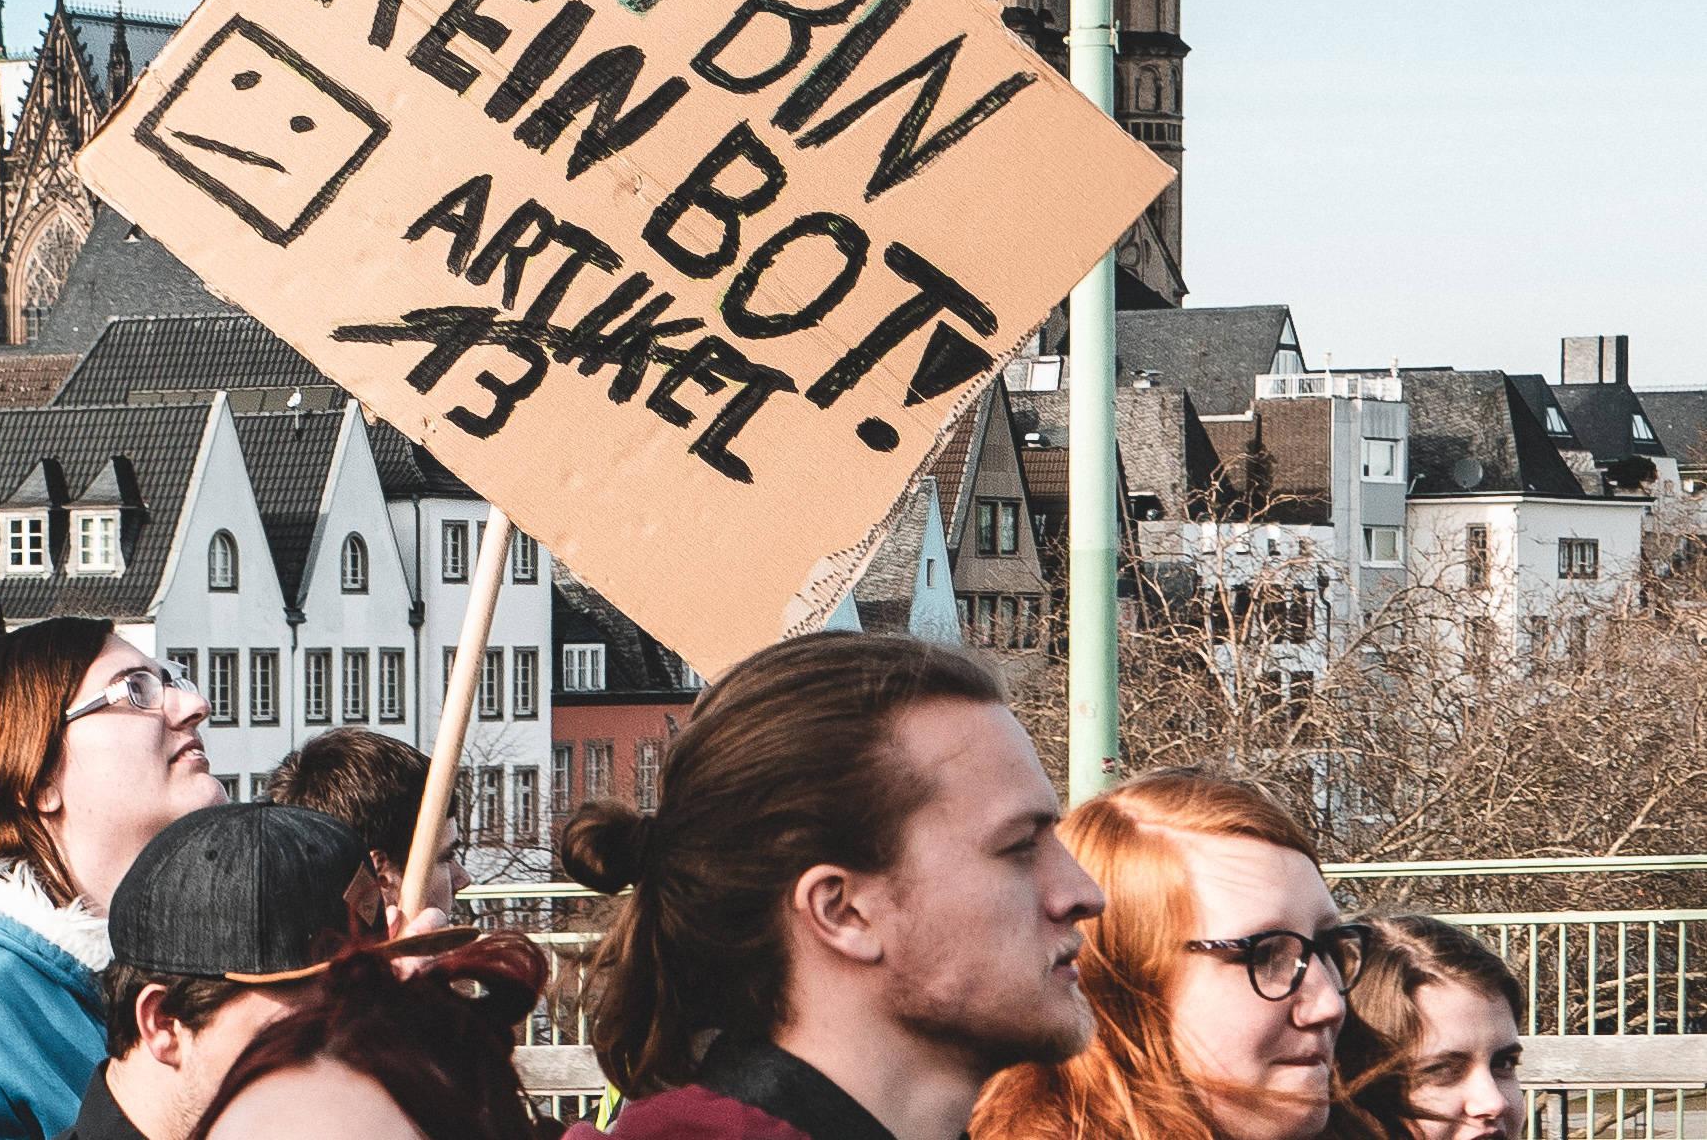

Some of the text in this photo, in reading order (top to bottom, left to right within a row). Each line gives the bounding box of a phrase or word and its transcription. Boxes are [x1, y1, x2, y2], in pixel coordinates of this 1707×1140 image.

[374, 306, 551, 440] 13
[402, 174, 795, 484] ARTIKEL
[641, 119, 999, 453] BOT!
